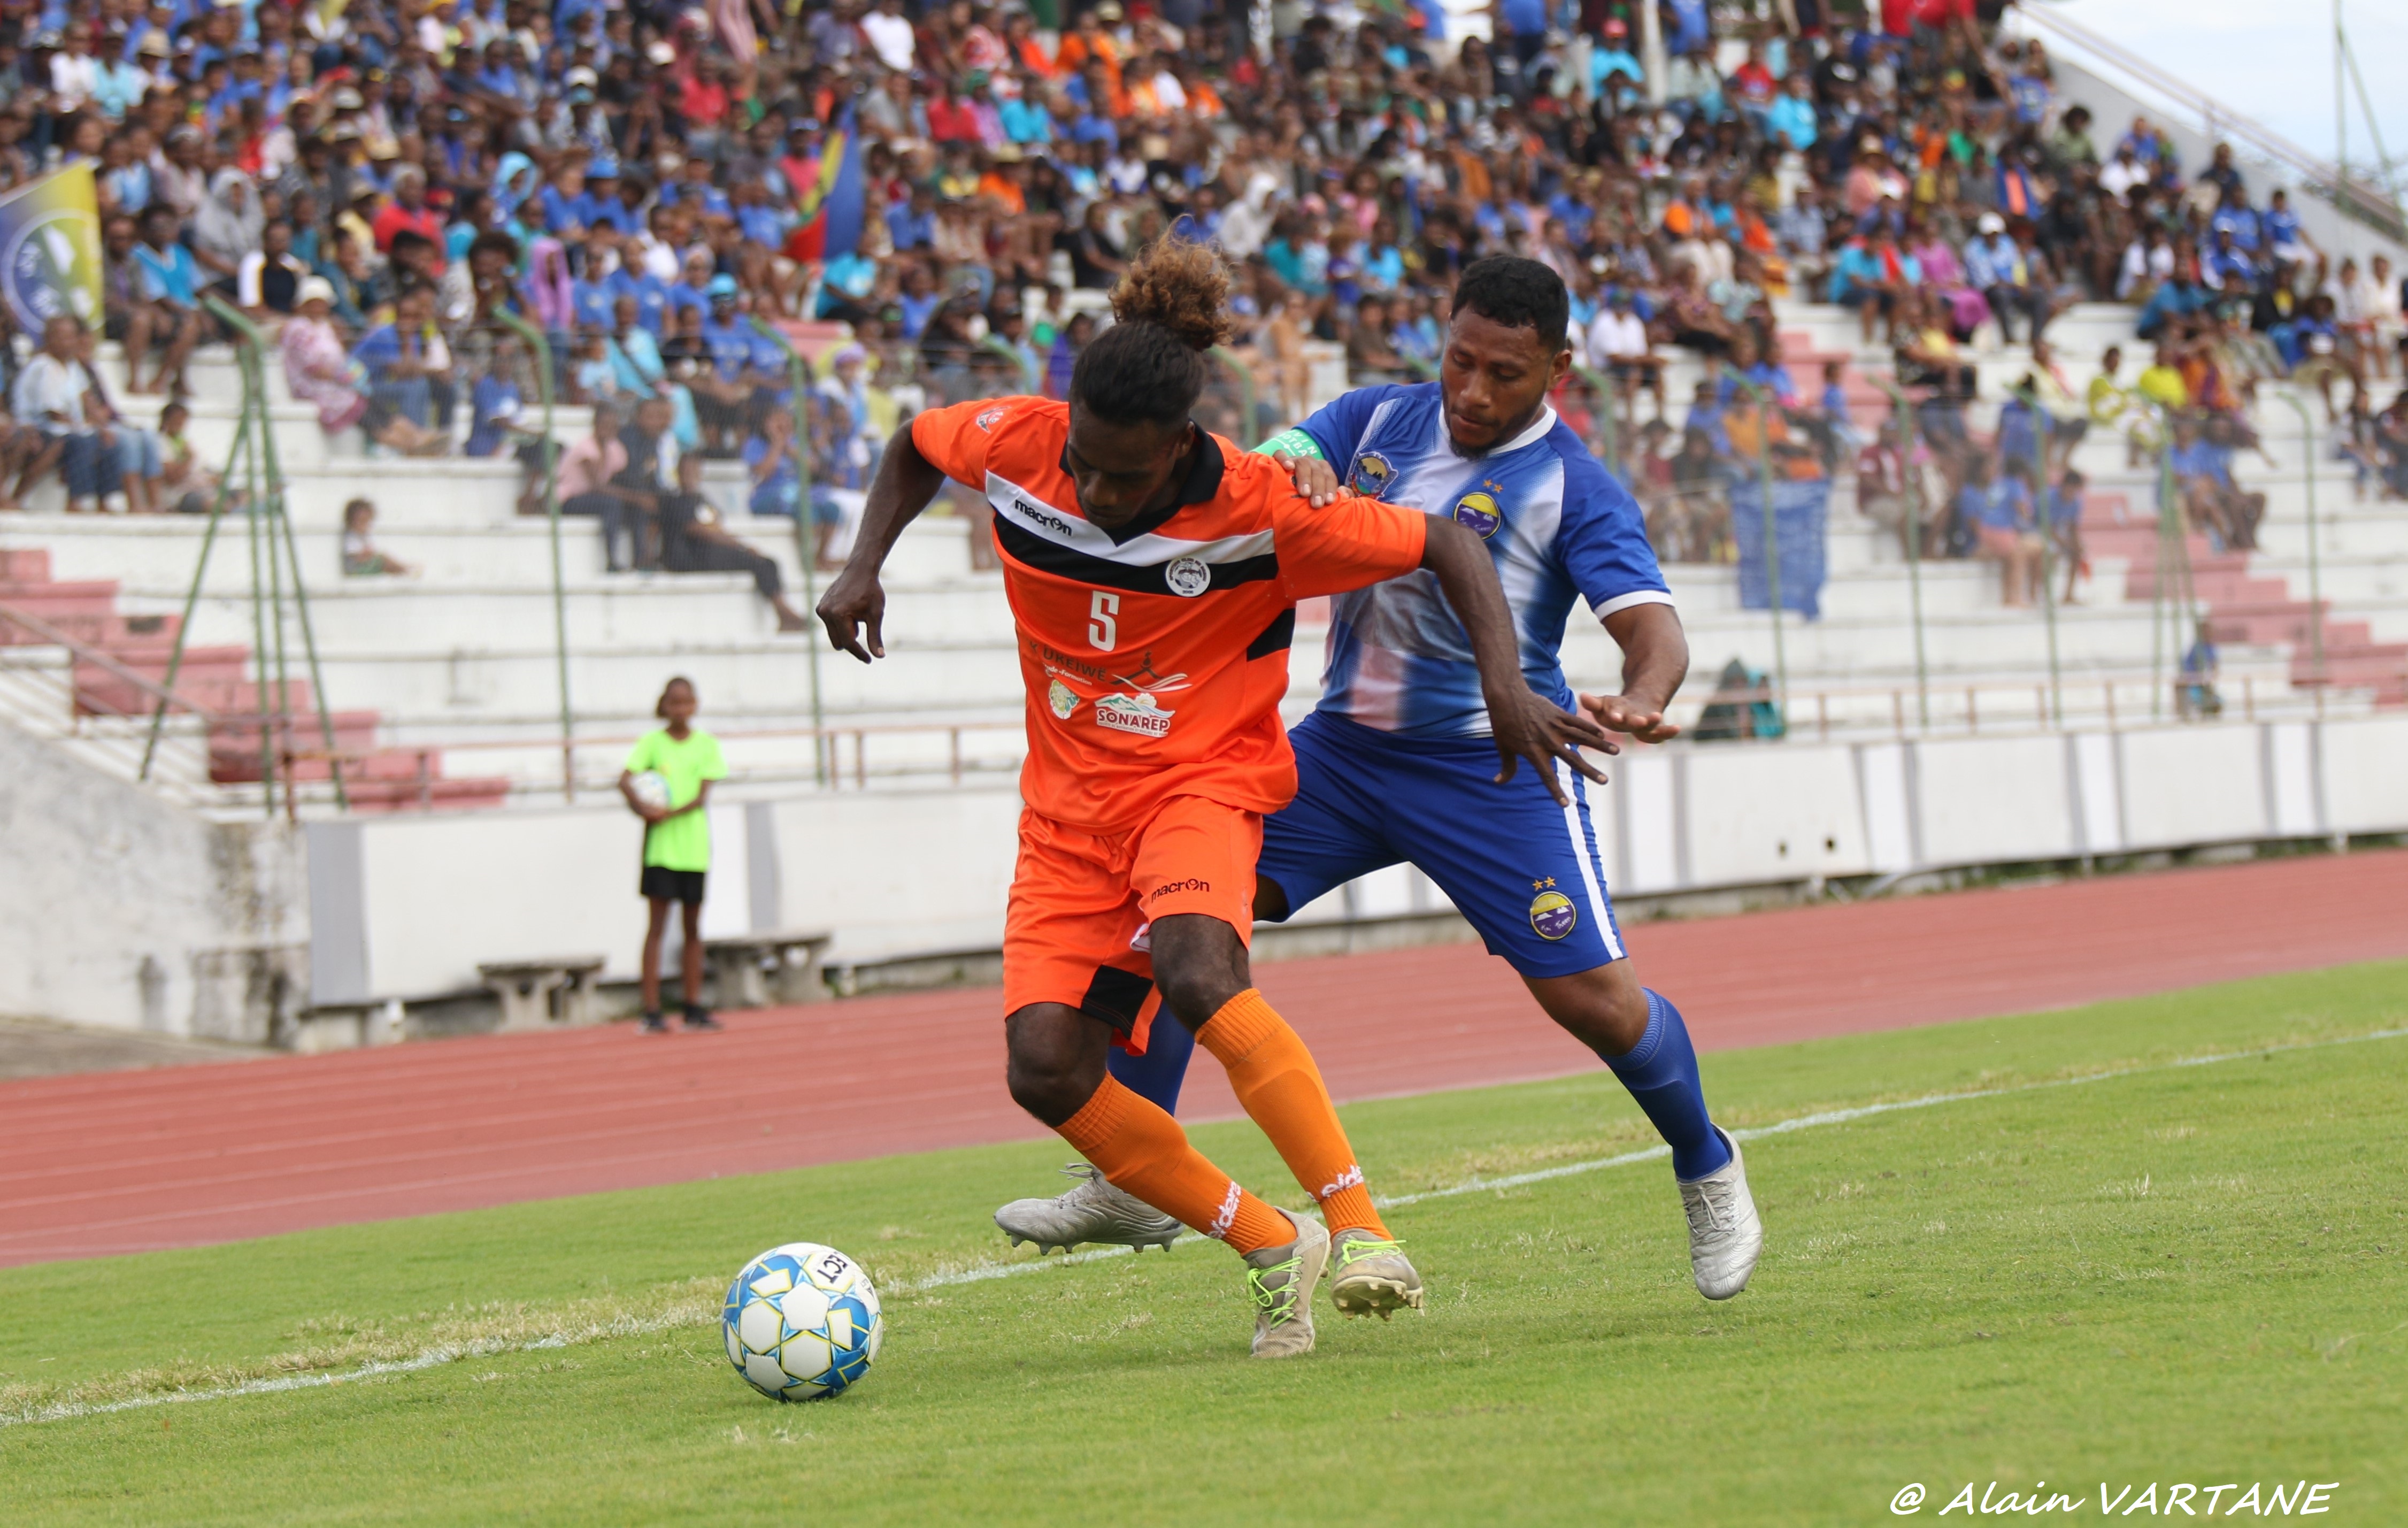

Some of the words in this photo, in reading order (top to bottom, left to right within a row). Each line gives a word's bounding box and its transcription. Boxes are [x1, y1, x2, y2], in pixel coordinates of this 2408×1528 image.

[1015, 499, 1072, 536] macron
[1089, 590, 1120, 652] 5
[1098, 709, 1170, 732] SONAREP
[1151, 878, 1210, 903] macron
[817, 1251, 849, 1285] ECT
